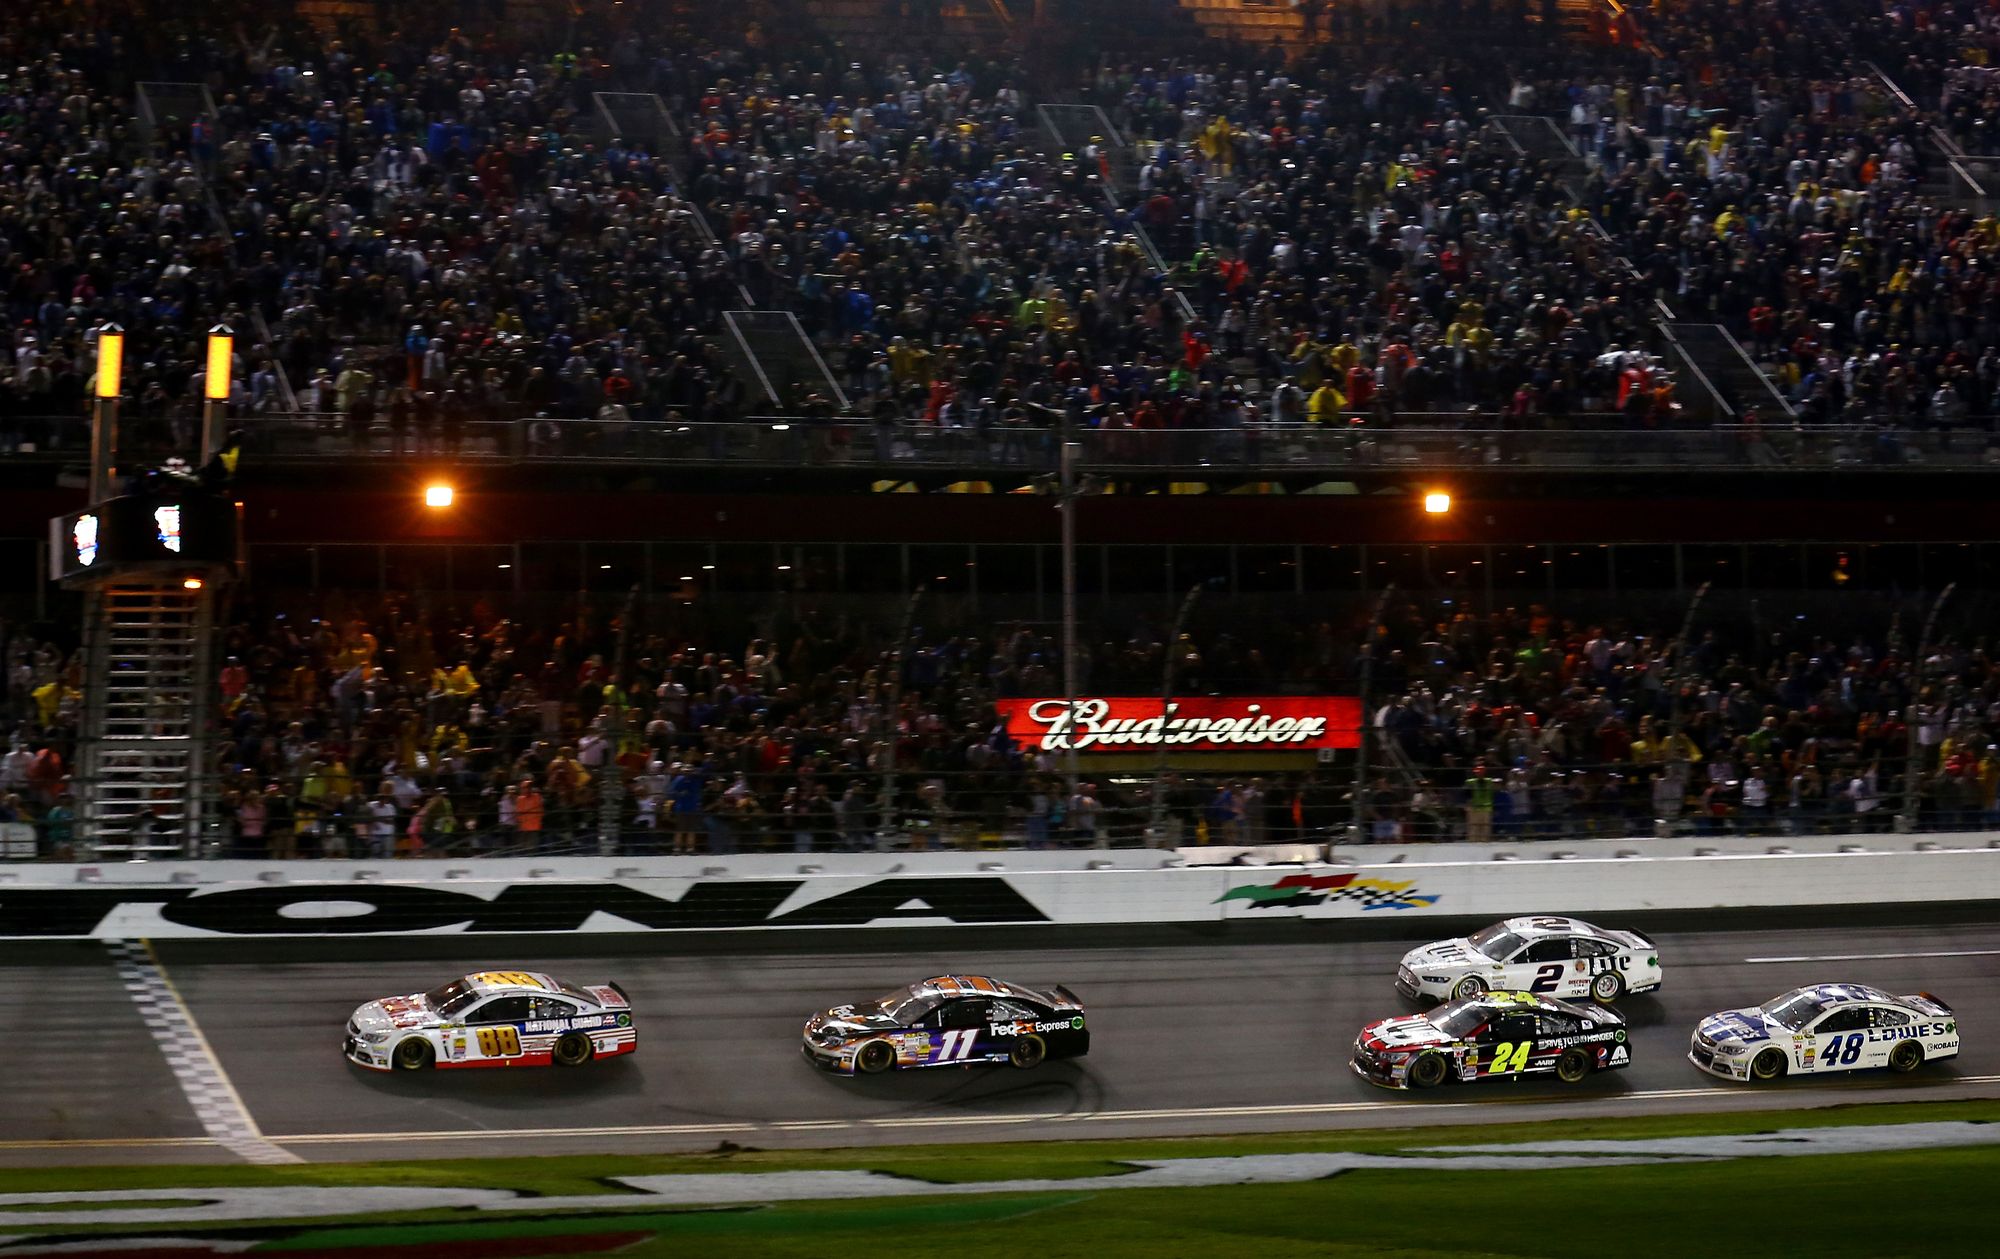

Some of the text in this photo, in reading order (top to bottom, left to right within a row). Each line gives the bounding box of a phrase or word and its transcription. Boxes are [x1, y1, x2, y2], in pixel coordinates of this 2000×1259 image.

[1028, 698, 1326, 750] Budweiser
[1530, 964, 1564, 992] 2
[525, 1019, 571, 1032] NATIONAL
[989, 1021, 1070, 1037] FedEx Express
[1867, 1022, 1945, 1043] LOWE'S
[476, 1026, 523, 1057] 88
[937, 1029, 979, 1060] 11
[1538, 1037, 1563, 1050] DRIVE
[1563, 1036, 1573, 1048] TO
[1820, 1033, 1864, 1067] 48
[1934, 1041, 1958, 1050] KOBALT
[1488, 1041, 1532, 1074] 24
